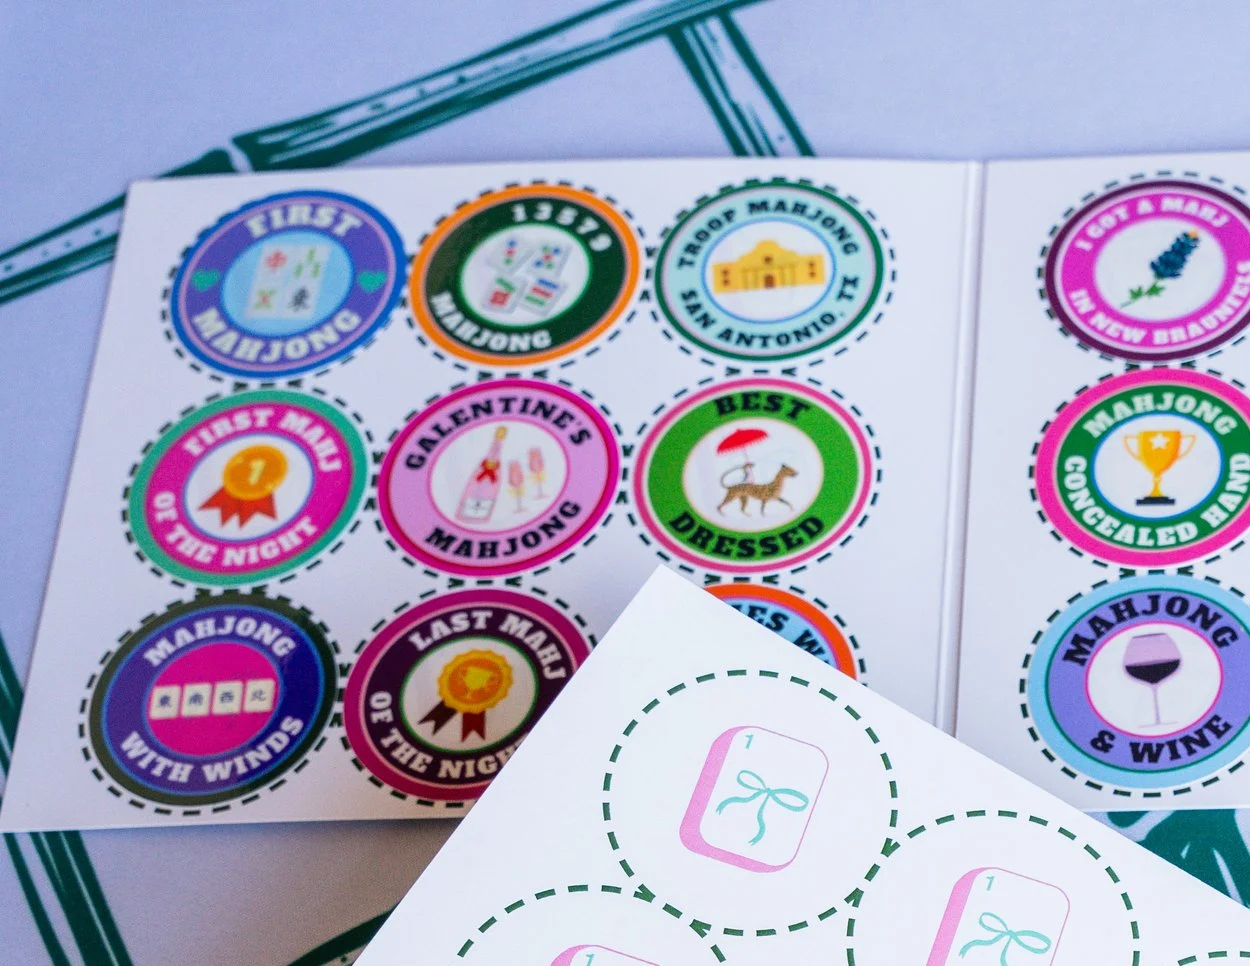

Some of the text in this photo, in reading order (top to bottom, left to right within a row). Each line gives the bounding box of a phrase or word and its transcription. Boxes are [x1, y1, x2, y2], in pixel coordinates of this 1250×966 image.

[245, 204, 363, 238] FIRST
[678, 200, 859, 268] TROOP MAHJONG
[1073, 196, 1231, 253] I GOT A MAHJ
[430, 290, 552, 352] MAHJONG
[680, 289, 716, 329] SAN
[837, 276, 859, 303] TX
[1068, 288, 1097, 315] IN
[1090, 311, 1147, 344] NEW
[193, 308, 361, 362] MAHJONG
[713, 392, 810, 418] BEST
[1082, 392, 1238, 439] MAHJONG
[183, 408, 342, 473] FIRST MAHJ
[1064, 455, 1199, 547] CONCEALED
[153, 490, 319, 567] OF THE NIGHT
[425, 500, 582, 559] MAHJONG
[669, 511, 825, 558] DRESSED
[143, 616, 296, 667] MAHJONG
[408, 611, 568, 680] LAST MAHJ
[1062, 594, 1239, 667] MAHJONG
[370, 691, 394, 724] OF
[121, 715, 304, 782] WITH WINDS
[381, 727, 434, 773] THE
[745, 734, 754, 749] 1
[1090, 714, 1233, 763] & WINE
[986, 876, 995, 891] 1
